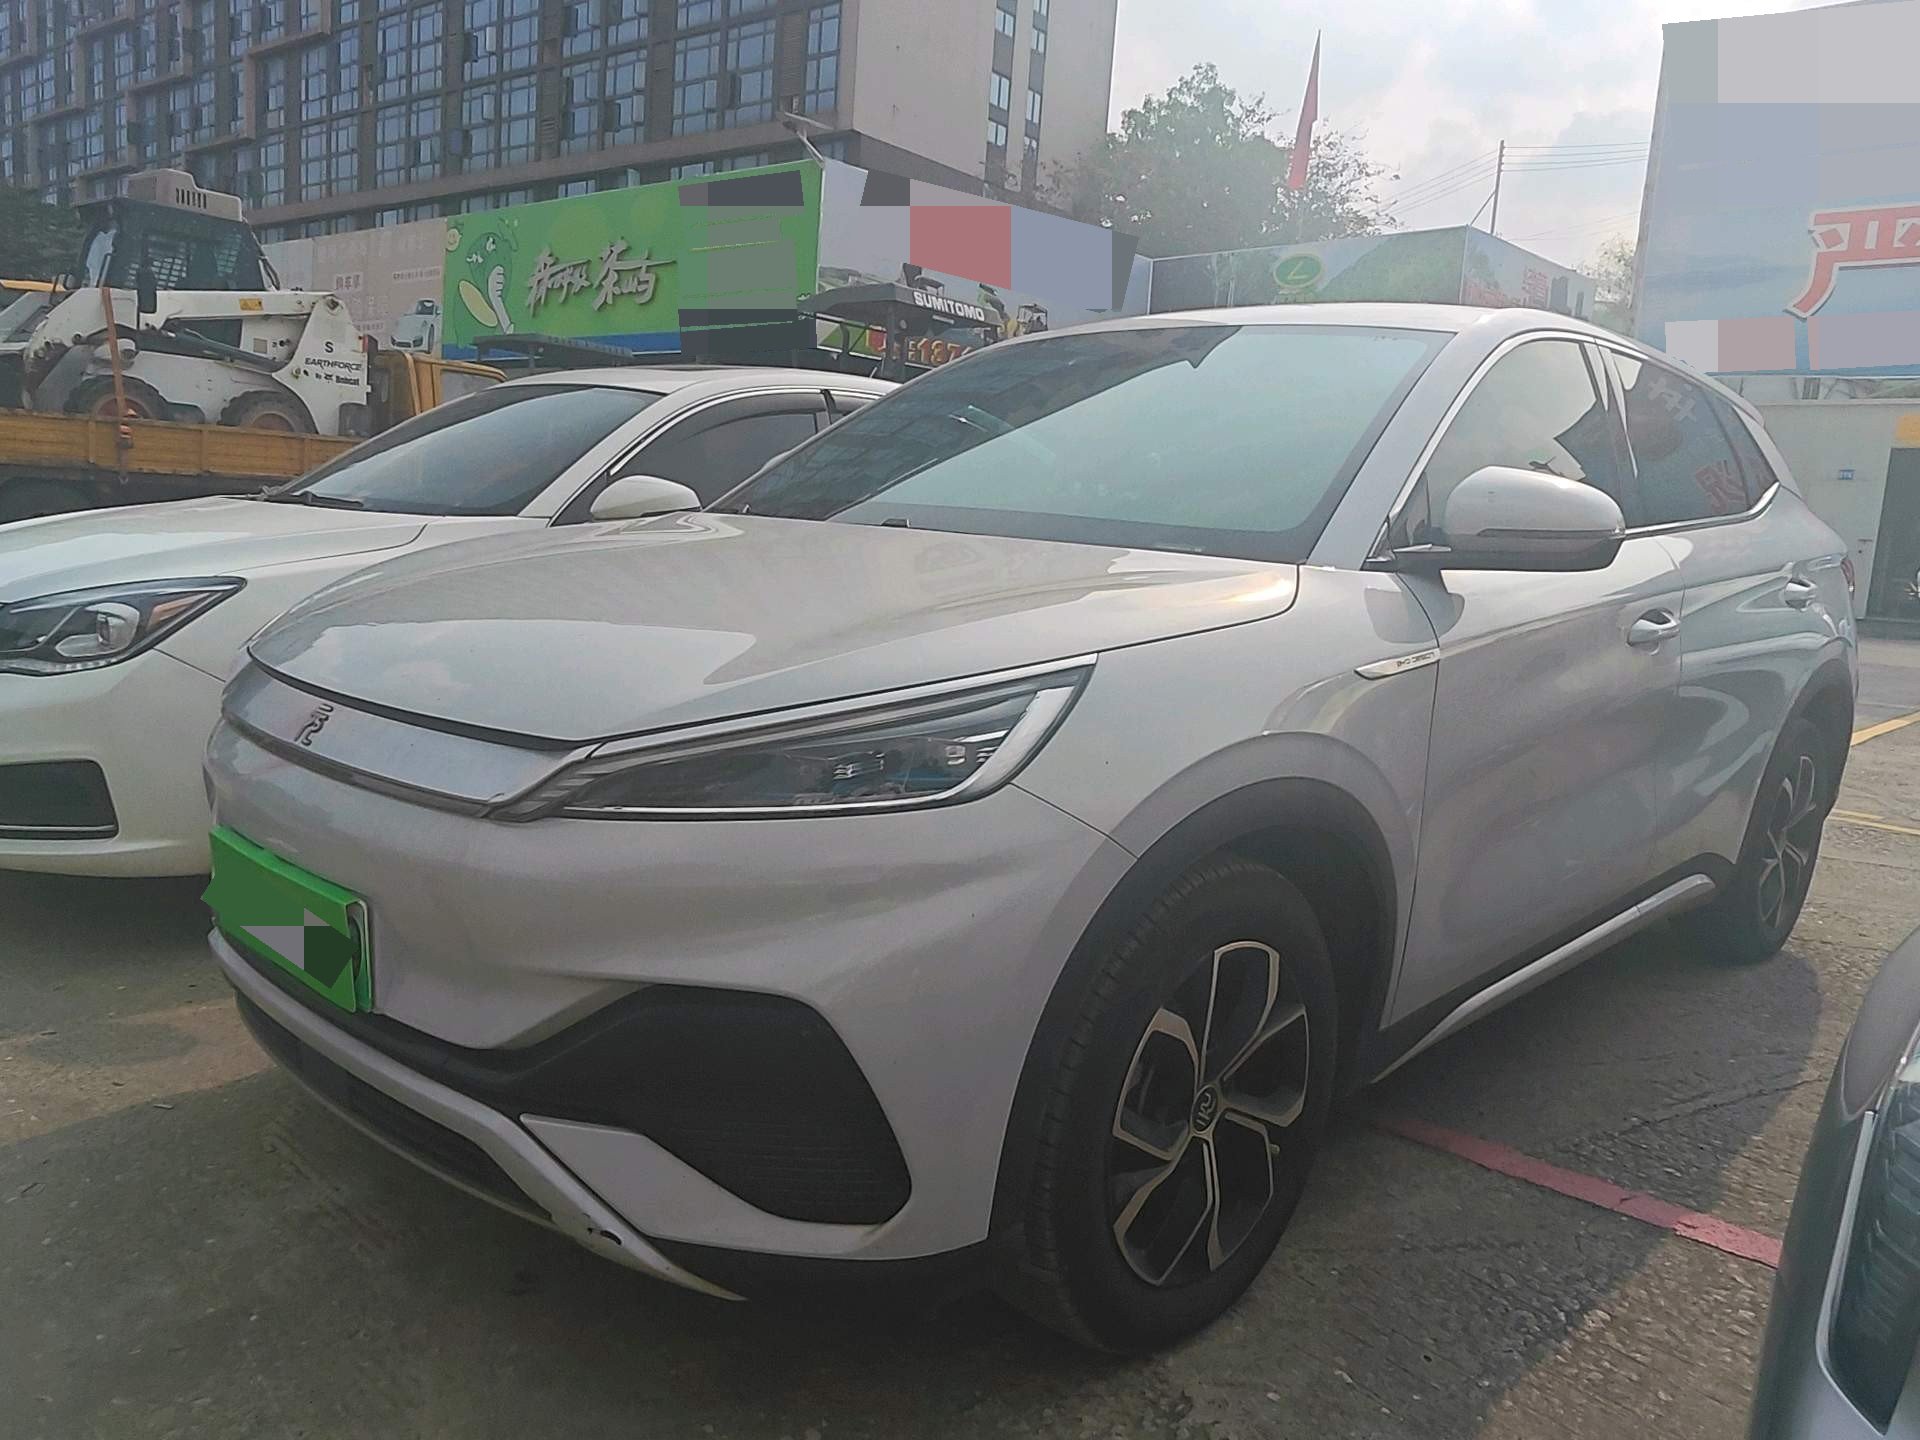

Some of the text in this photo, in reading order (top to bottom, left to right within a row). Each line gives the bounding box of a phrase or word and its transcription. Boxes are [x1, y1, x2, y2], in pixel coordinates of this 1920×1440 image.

[913, 290, 985, 321] SUMITOMO
[324, 341, 334, 353] S
[304, 357, 362, 373] EARTHFORCE
